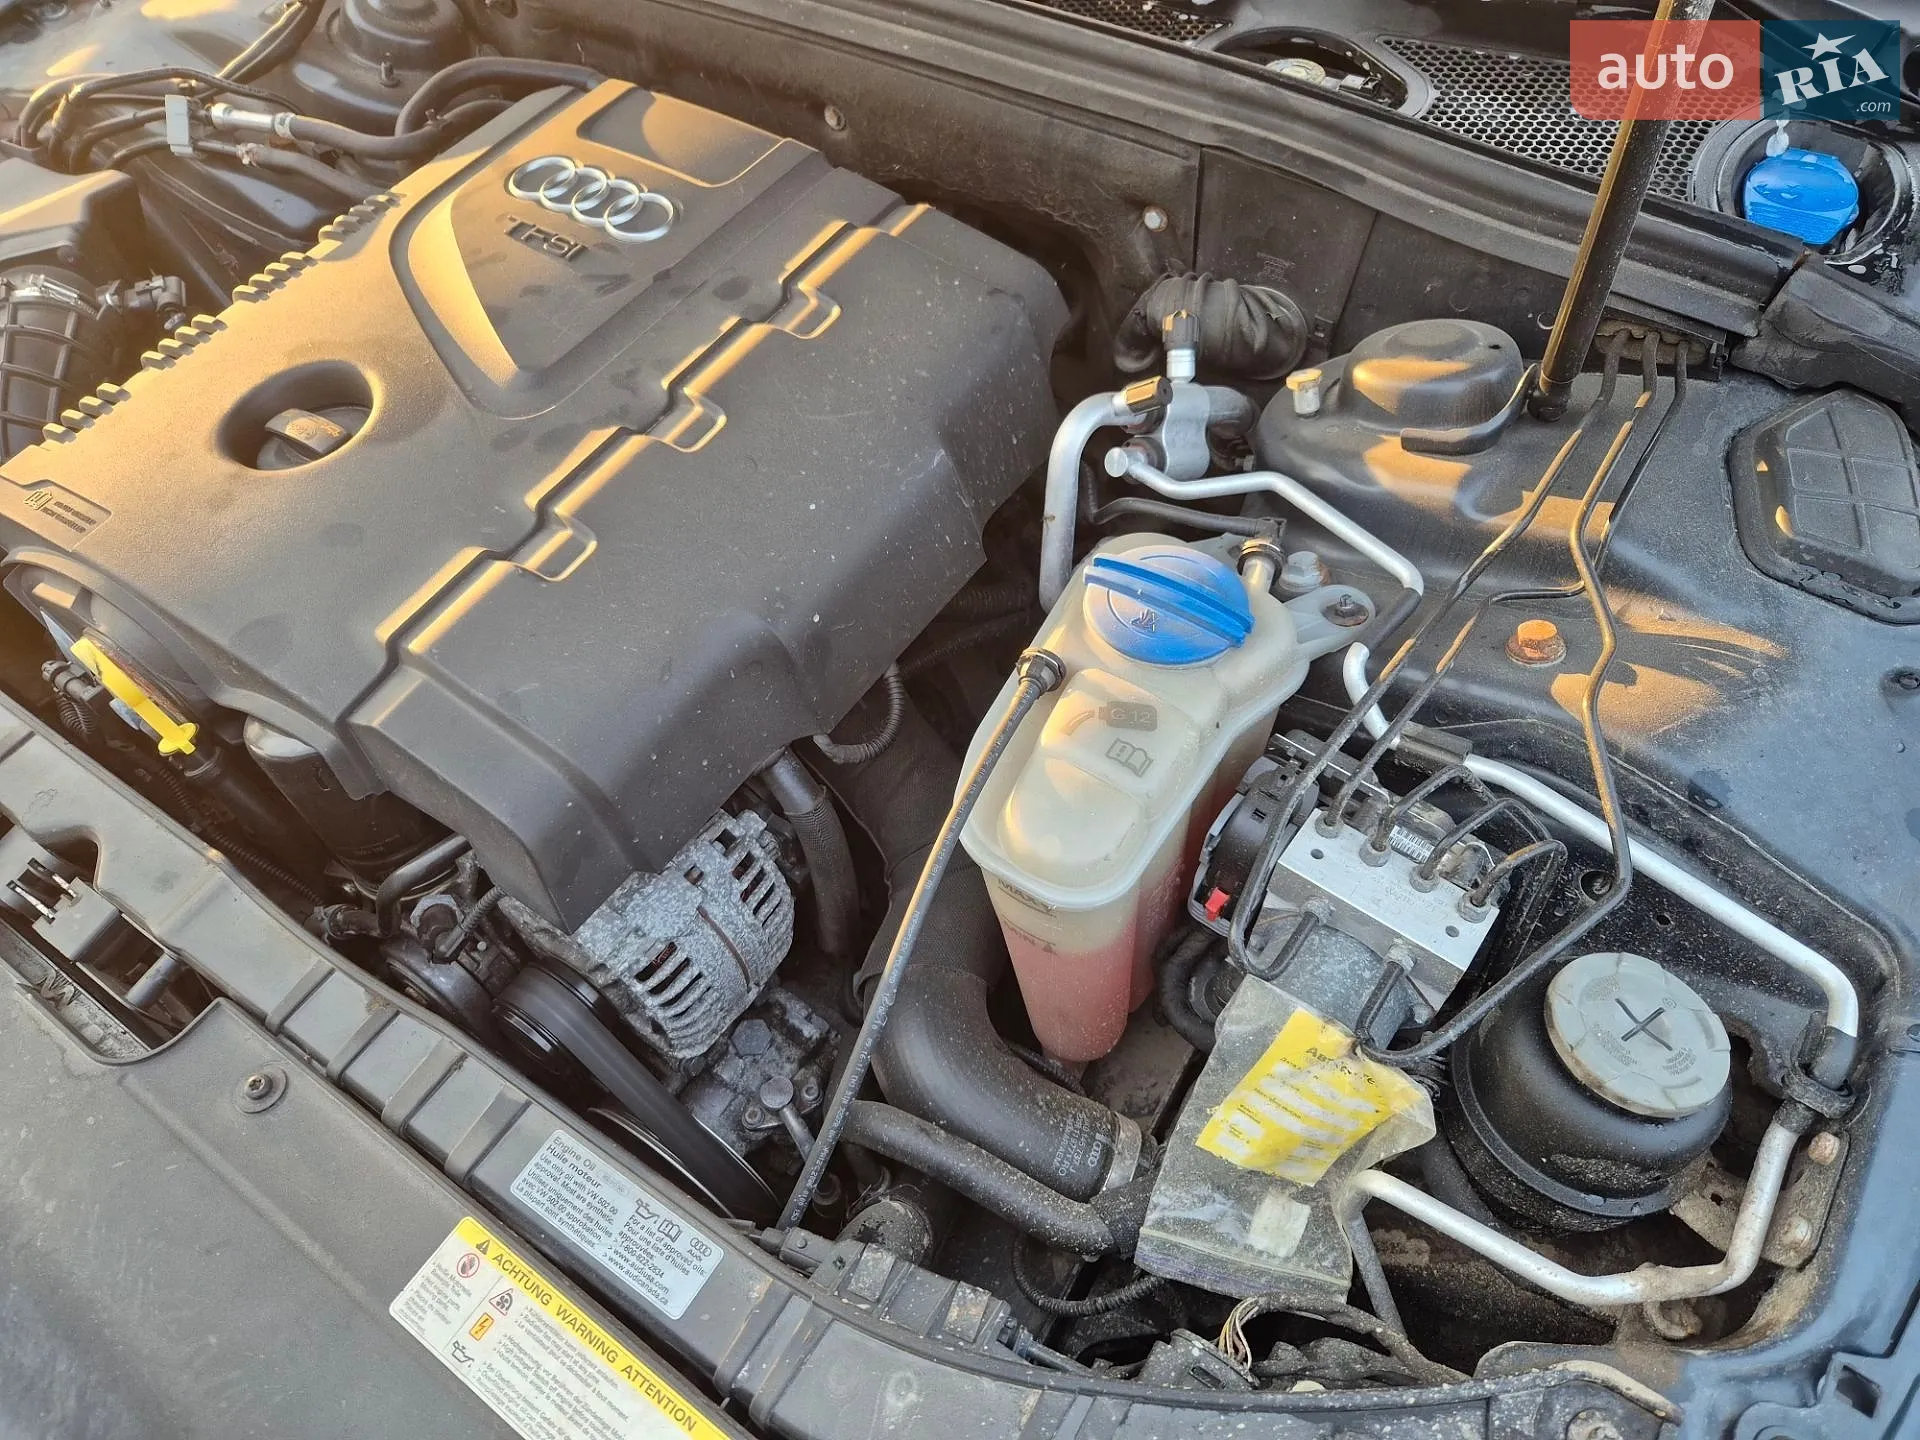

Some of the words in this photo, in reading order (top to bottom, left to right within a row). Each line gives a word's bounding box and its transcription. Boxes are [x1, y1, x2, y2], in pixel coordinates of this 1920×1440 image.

[504, 215, 589, 262] TFSI
[546, 1144, 569, 1164] Huile
[568, 1161, 602, 1189] moteur
[551, 1135, 584, 1163] Engine
[581, 1157, 597, 1171] Oil
[521, 1176, 537, 1190] avec
[535, 1186, 548, 1199] VW
[545, 1194, 559, 1207] 502
[522, 1189, 545, 1209] plupart
[544, 1205, 559, 1219] sont
[539, 1153, 553, 1165] Use
[550, 1161, 566, 1176] only
[563, 1171, 574, 1182] oil
[572, 1178, 587, 1191] with
[585, 1187, 599, 1200] VW
[596, 1196, 610, 1209] 502
[608, 1205, 619, 1216] 00
[560, 1180, 577, 1196] Most
[575, 1193, 587, 1203] are
[546, 1184, 584, 1215] uniquement
[581, 1210, 595, 1223] des
[593, 1219, 613, 1238] huiles
[623, 1221, 640, 1236] Pour
[638, 1233, 652, 1246] une
[650, 1242, 666, 1256] liste
[628, 1214, 641, 1227] For
[644, 1226, 657, 1238] list
[654, 1234, 664, 1244] of
[661, 1239, 693, 1267] approved
[491, 1250, 553, 1306] ACHTUNG
[553, 1304, 619, 1364] WARNING
[619, 1361, 698, 1432] ATTENTION
